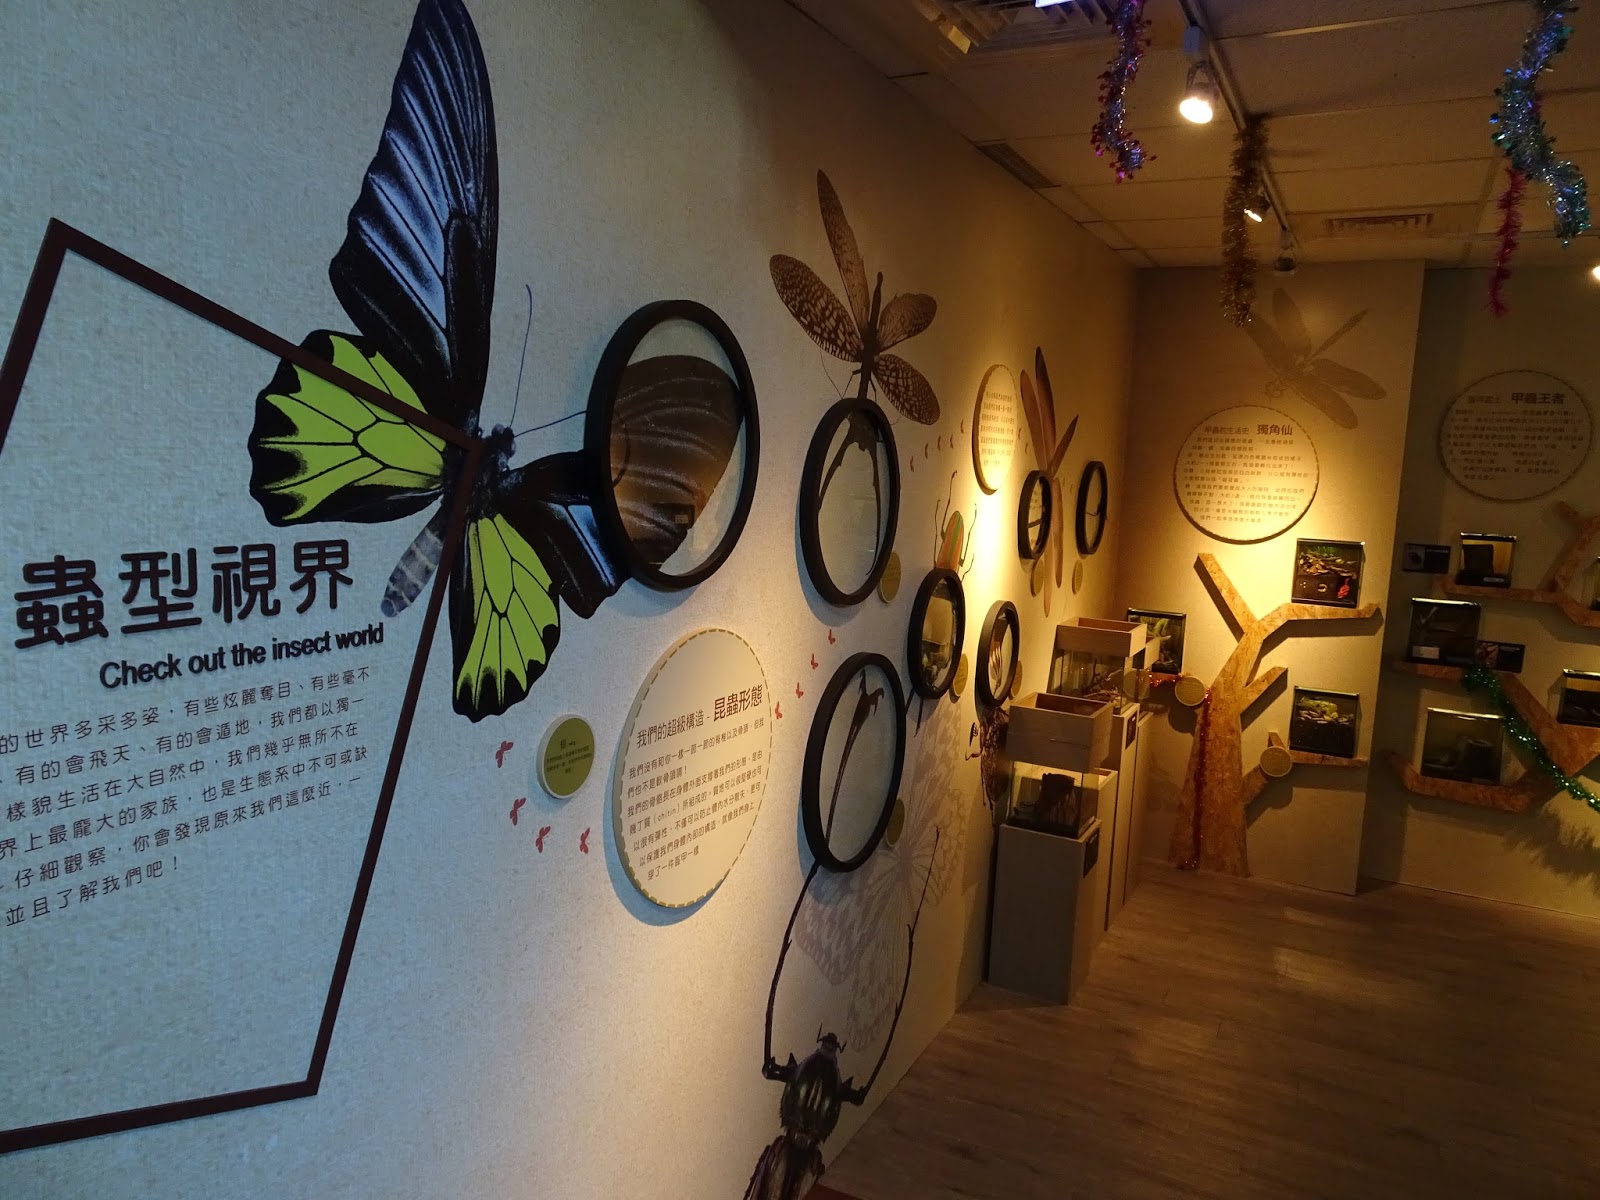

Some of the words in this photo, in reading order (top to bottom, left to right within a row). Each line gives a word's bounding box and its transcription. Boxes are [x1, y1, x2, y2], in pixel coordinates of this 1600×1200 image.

[1257, 423, 1293, 436] 獨角仙
[14, 539, 354, 650] 蟲型視界
[100, 653, 183, 689] Check
[188, 646, 227, 675] out
[232, 642, 267, 667] the
[272, 636, 332, 664] insect
[335, 622, 385, 648] world
[636, 710, 704, 749] 我們的超級構造
[713, 684, 763, 722] 昆蟲形態
[0, 776, 361, 890] 仔細觀察，你會發現原來我們這麼近，一
